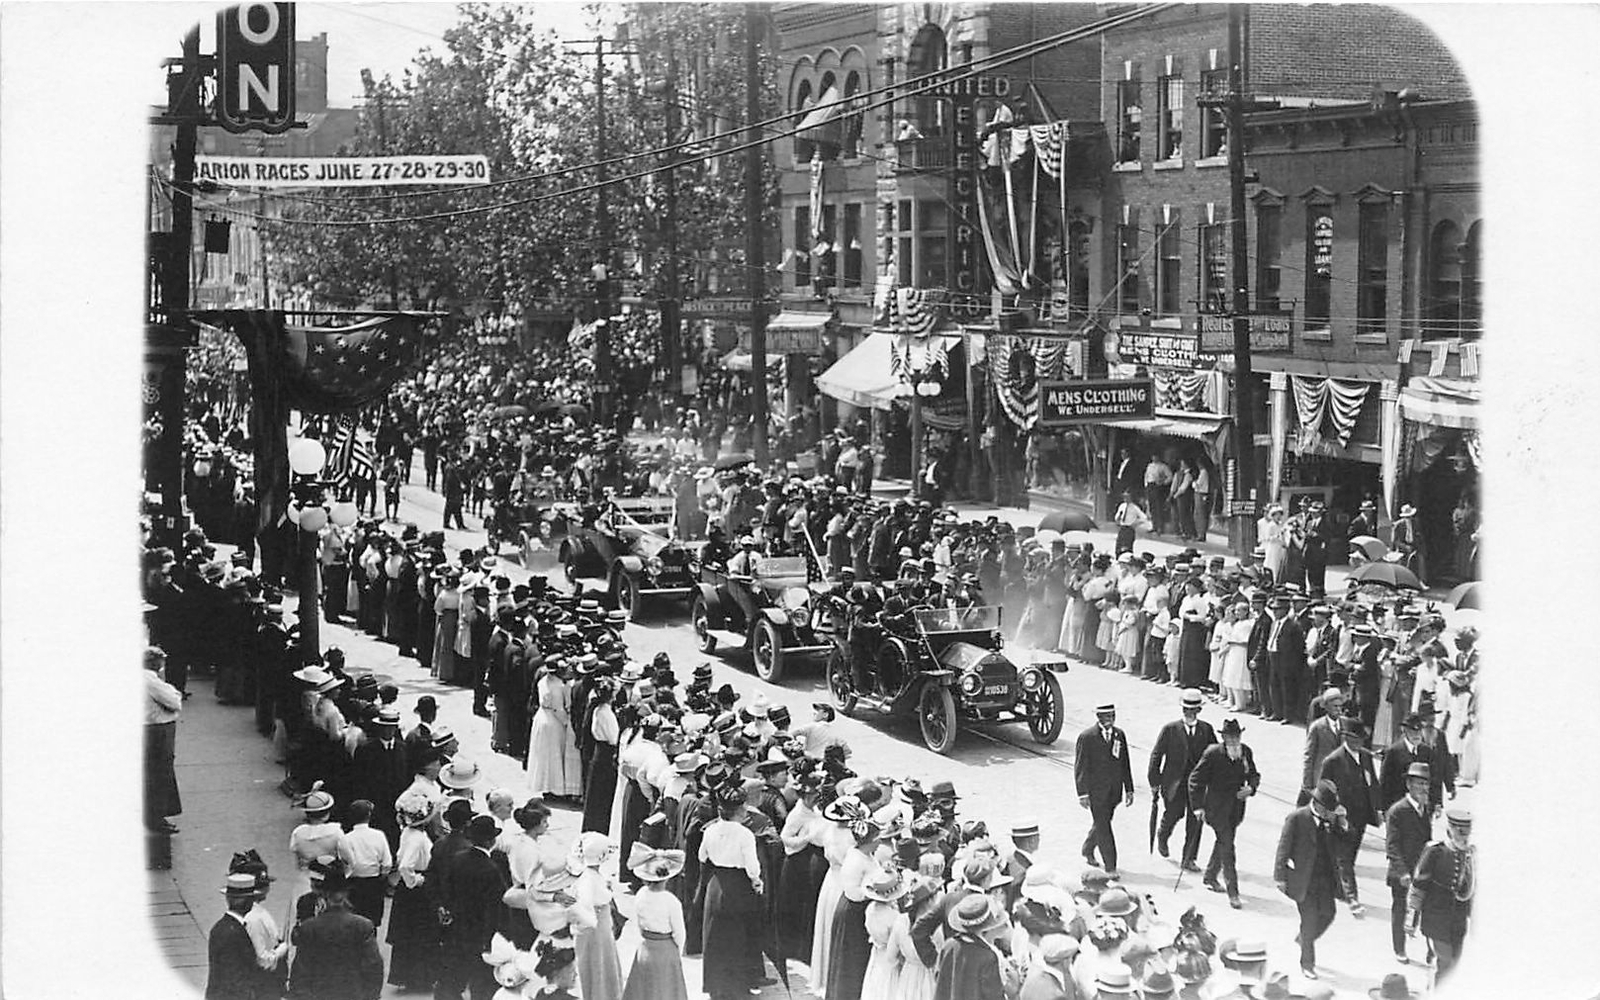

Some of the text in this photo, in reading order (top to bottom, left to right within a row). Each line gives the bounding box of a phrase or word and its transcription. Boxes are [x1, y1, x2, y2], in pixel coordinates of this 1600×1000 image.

[918, 77, 1010, 96] UNITED
[256, 163, 309, 180] RACES
[316, 163, 362, 180] JUNE
[957, 106, 972, 289] ELECTRIC
[1120, 346, 1149, 356] MENS
[1047, 389, 1146, 406] MENS CLOTHING
[1058, 405, 1073, 415] WE
